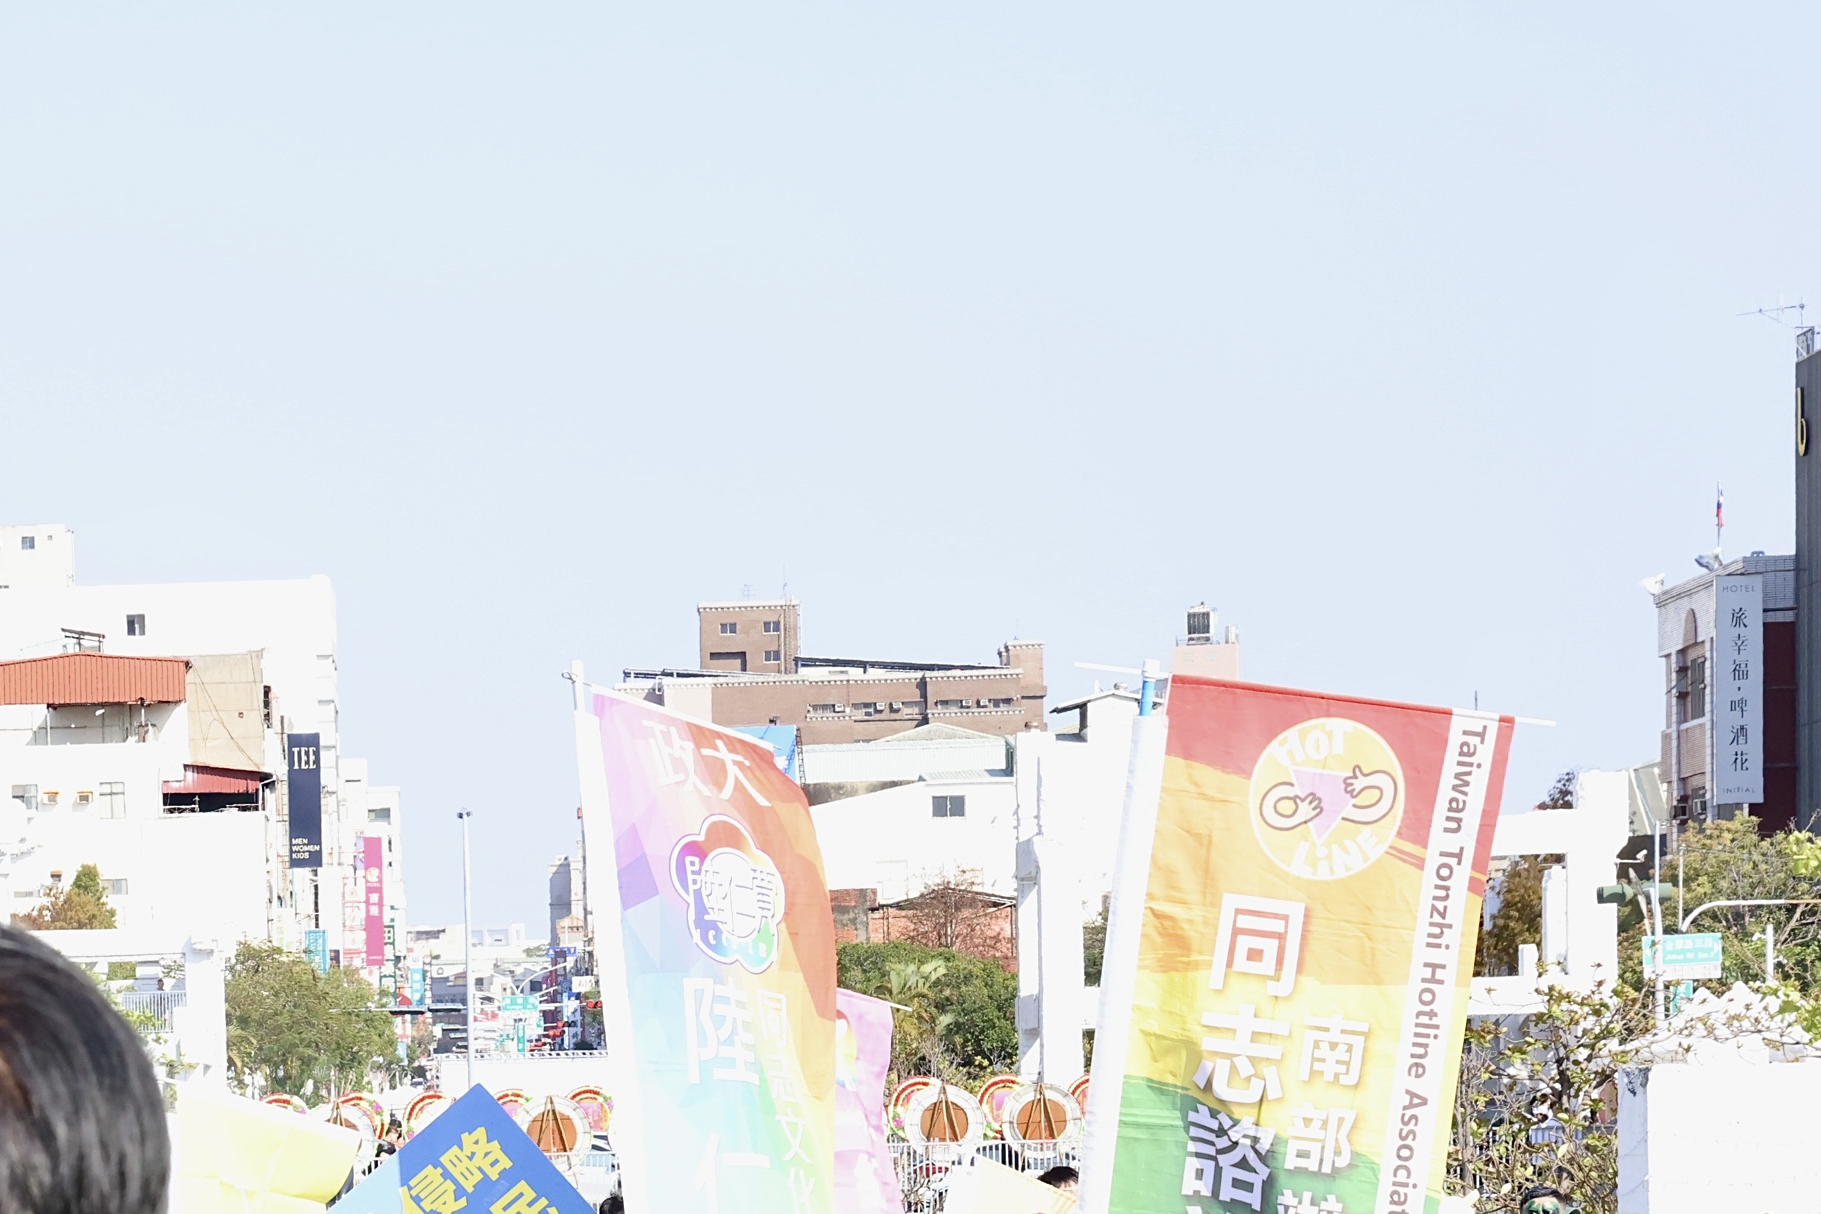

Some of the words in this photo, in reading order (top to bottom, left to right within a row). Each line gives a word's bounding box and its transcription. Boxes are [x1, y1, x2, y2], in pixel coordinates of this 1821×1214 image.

[1723, 585, 1756, 593] HOTEL
[292, 747, 317, 769] TEE
[641, 720, 772, 807] 政大
[1270, 717, 1355, 769] HOT
[1442, 725, 1487, 834] Taiwan
[1723, 786, 1755, 794] INITIAL
[1426, 846, 1465, 953] Tonzhi
[1407, 963, 1448, 1080] Hotline
